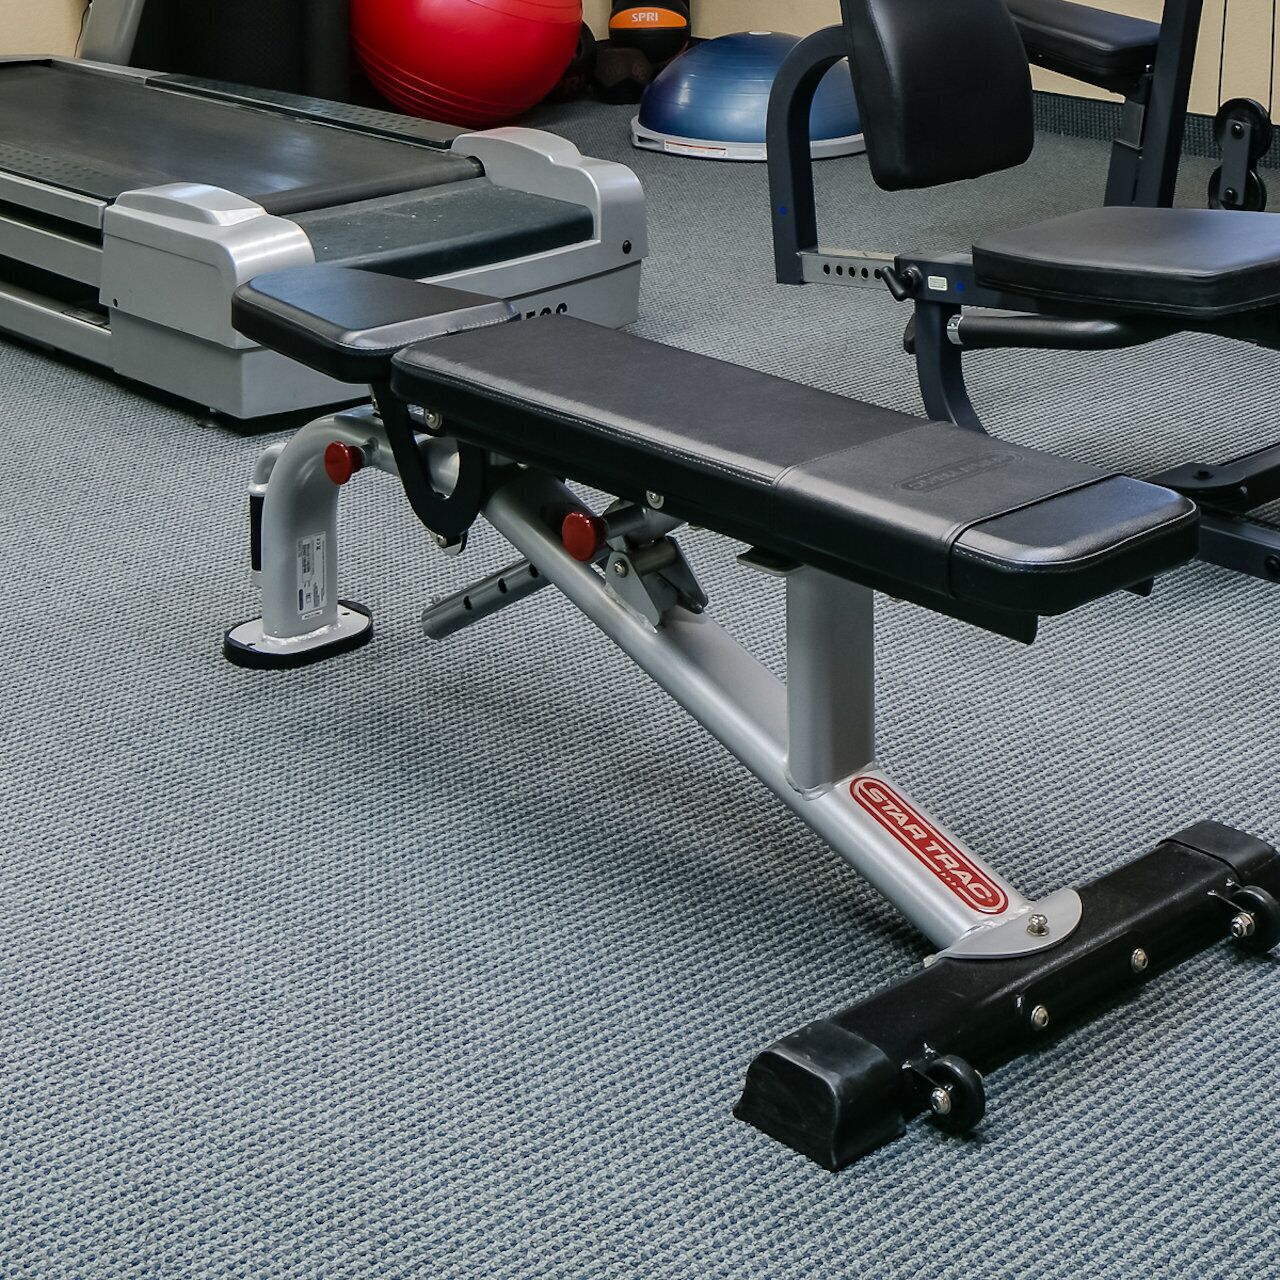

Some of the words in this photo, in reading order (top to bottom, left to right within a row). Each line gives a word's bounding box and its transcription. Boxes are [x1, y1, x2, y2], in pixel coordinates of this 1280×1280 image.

[631, 12, 659, 23] SPRI
[866, 786, 928, 841] STAR
[923, 839, 993, 900] TRAC
